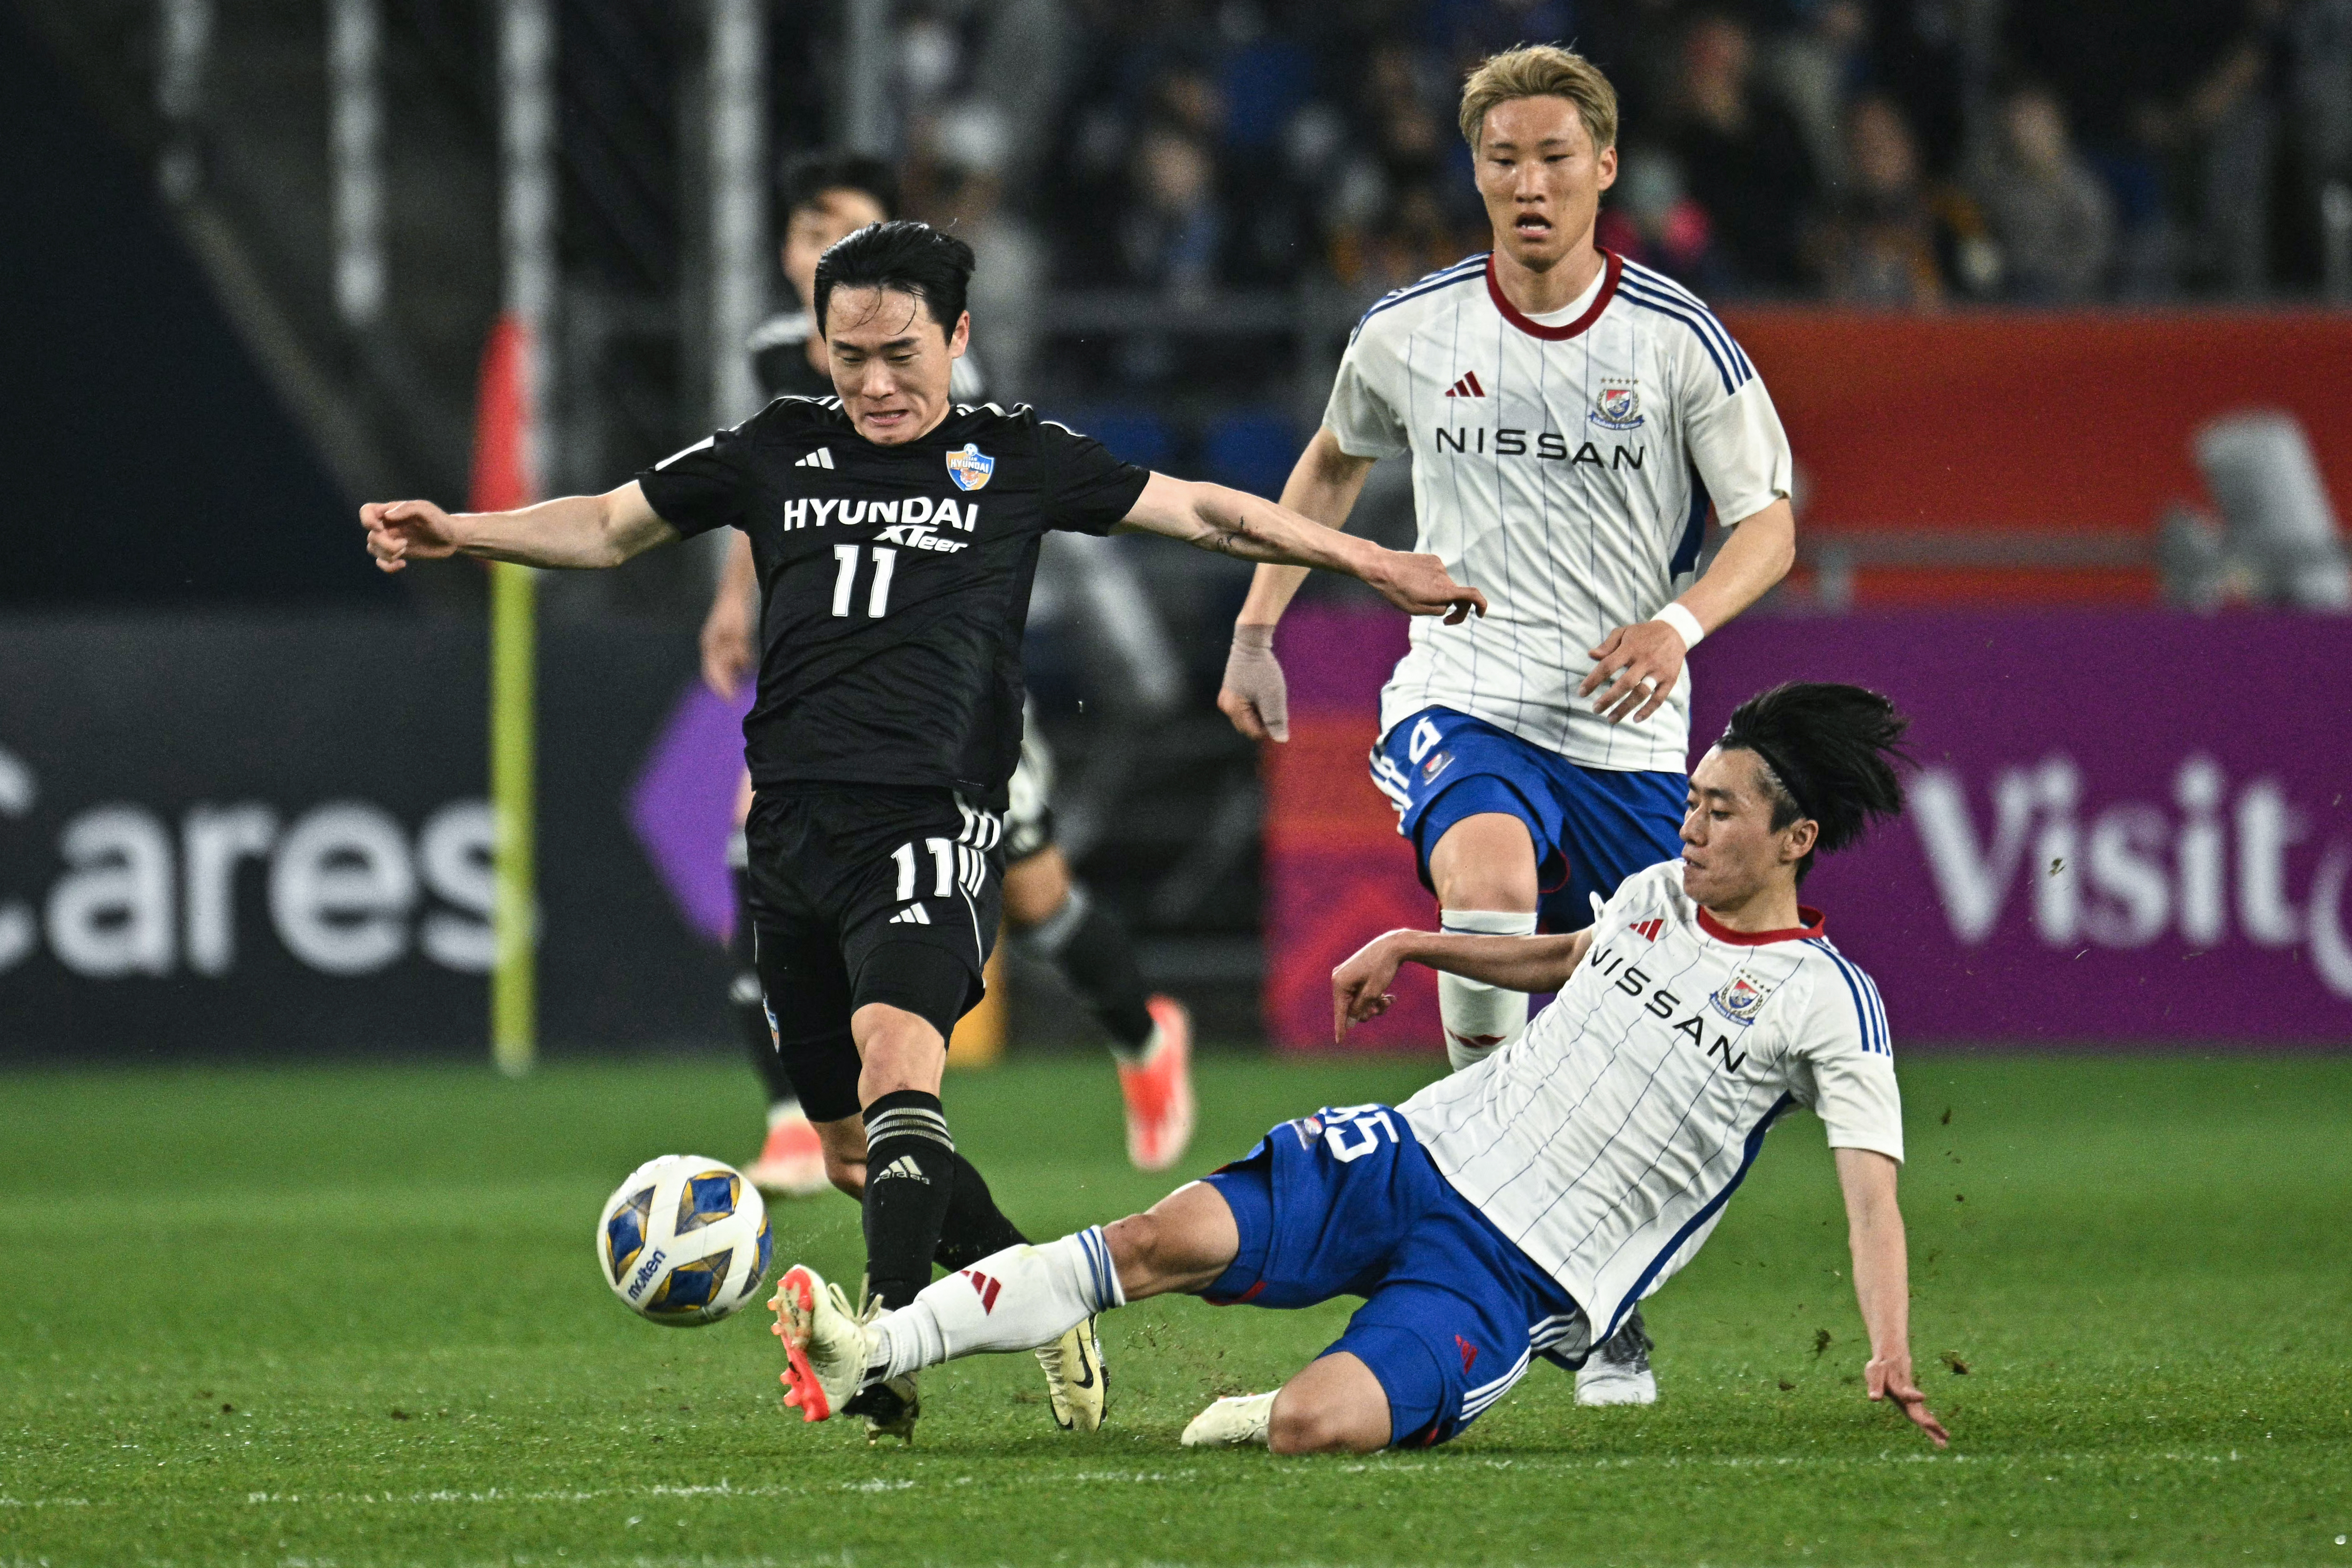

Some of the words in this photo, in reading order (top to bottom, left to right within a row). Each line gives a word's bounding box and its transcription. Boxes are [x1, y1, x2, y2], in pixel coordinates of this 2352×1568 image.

[950, 459, 989, 473] HYUNDAI
[1436, 428, 1644, 470] NISSAN
[784, 497, 979, 532] HYUNDAI
[832, 544, 897, 617] 11
[1409, 716, 1442, 765] 4
[890, 838, 953, 901] 11
[628, 1249, 666, 1300] molten
